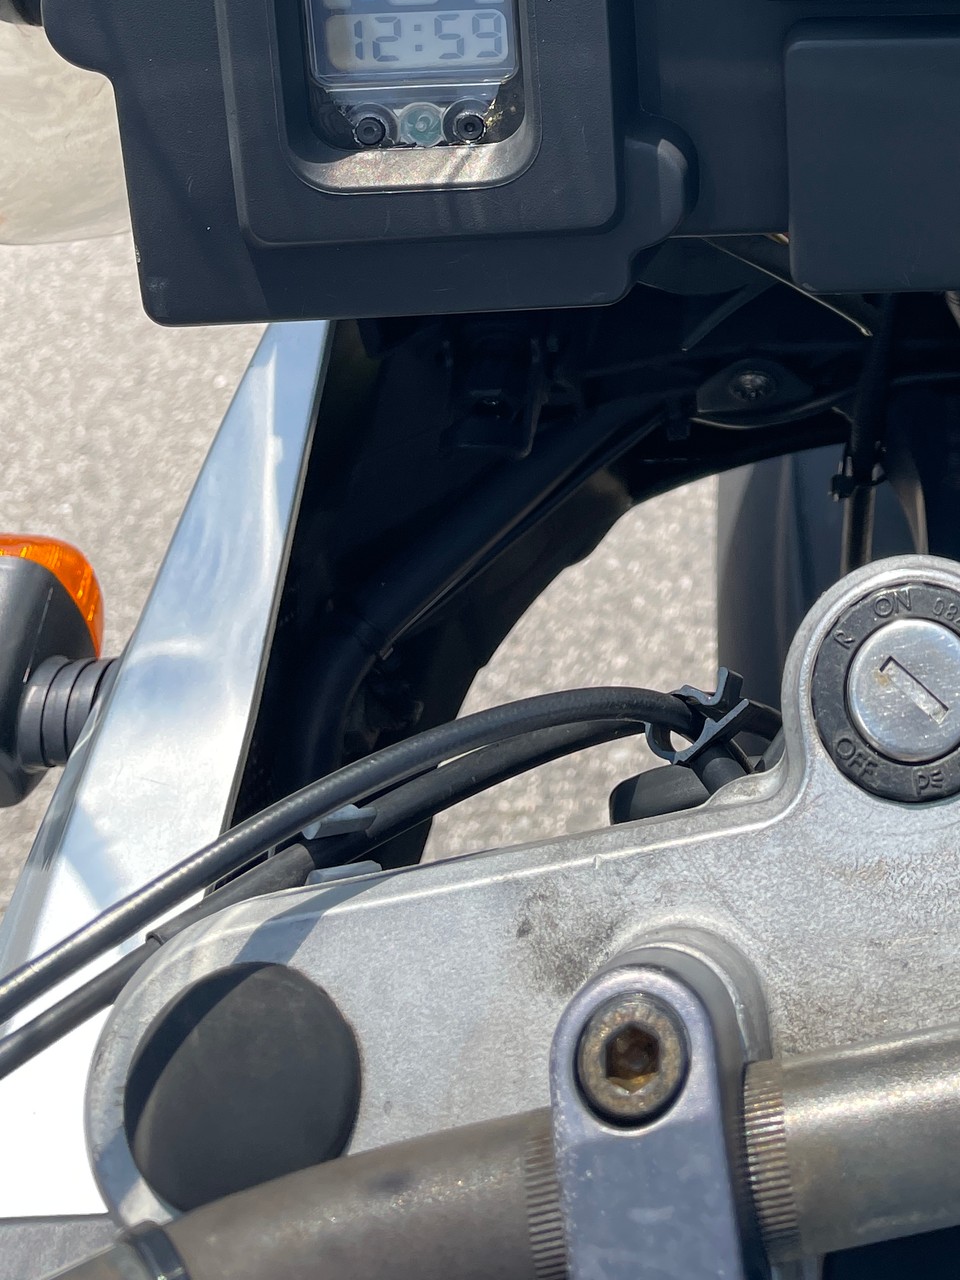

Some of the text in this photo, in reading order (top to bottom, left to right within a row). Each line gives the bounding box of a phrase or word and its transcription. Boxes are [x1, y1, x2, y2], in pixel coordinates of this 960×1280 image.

[354, 14, 502, 61] 12:59
[873, 590, 912, 617] ON
[835, 737, 880, 777] OFF
